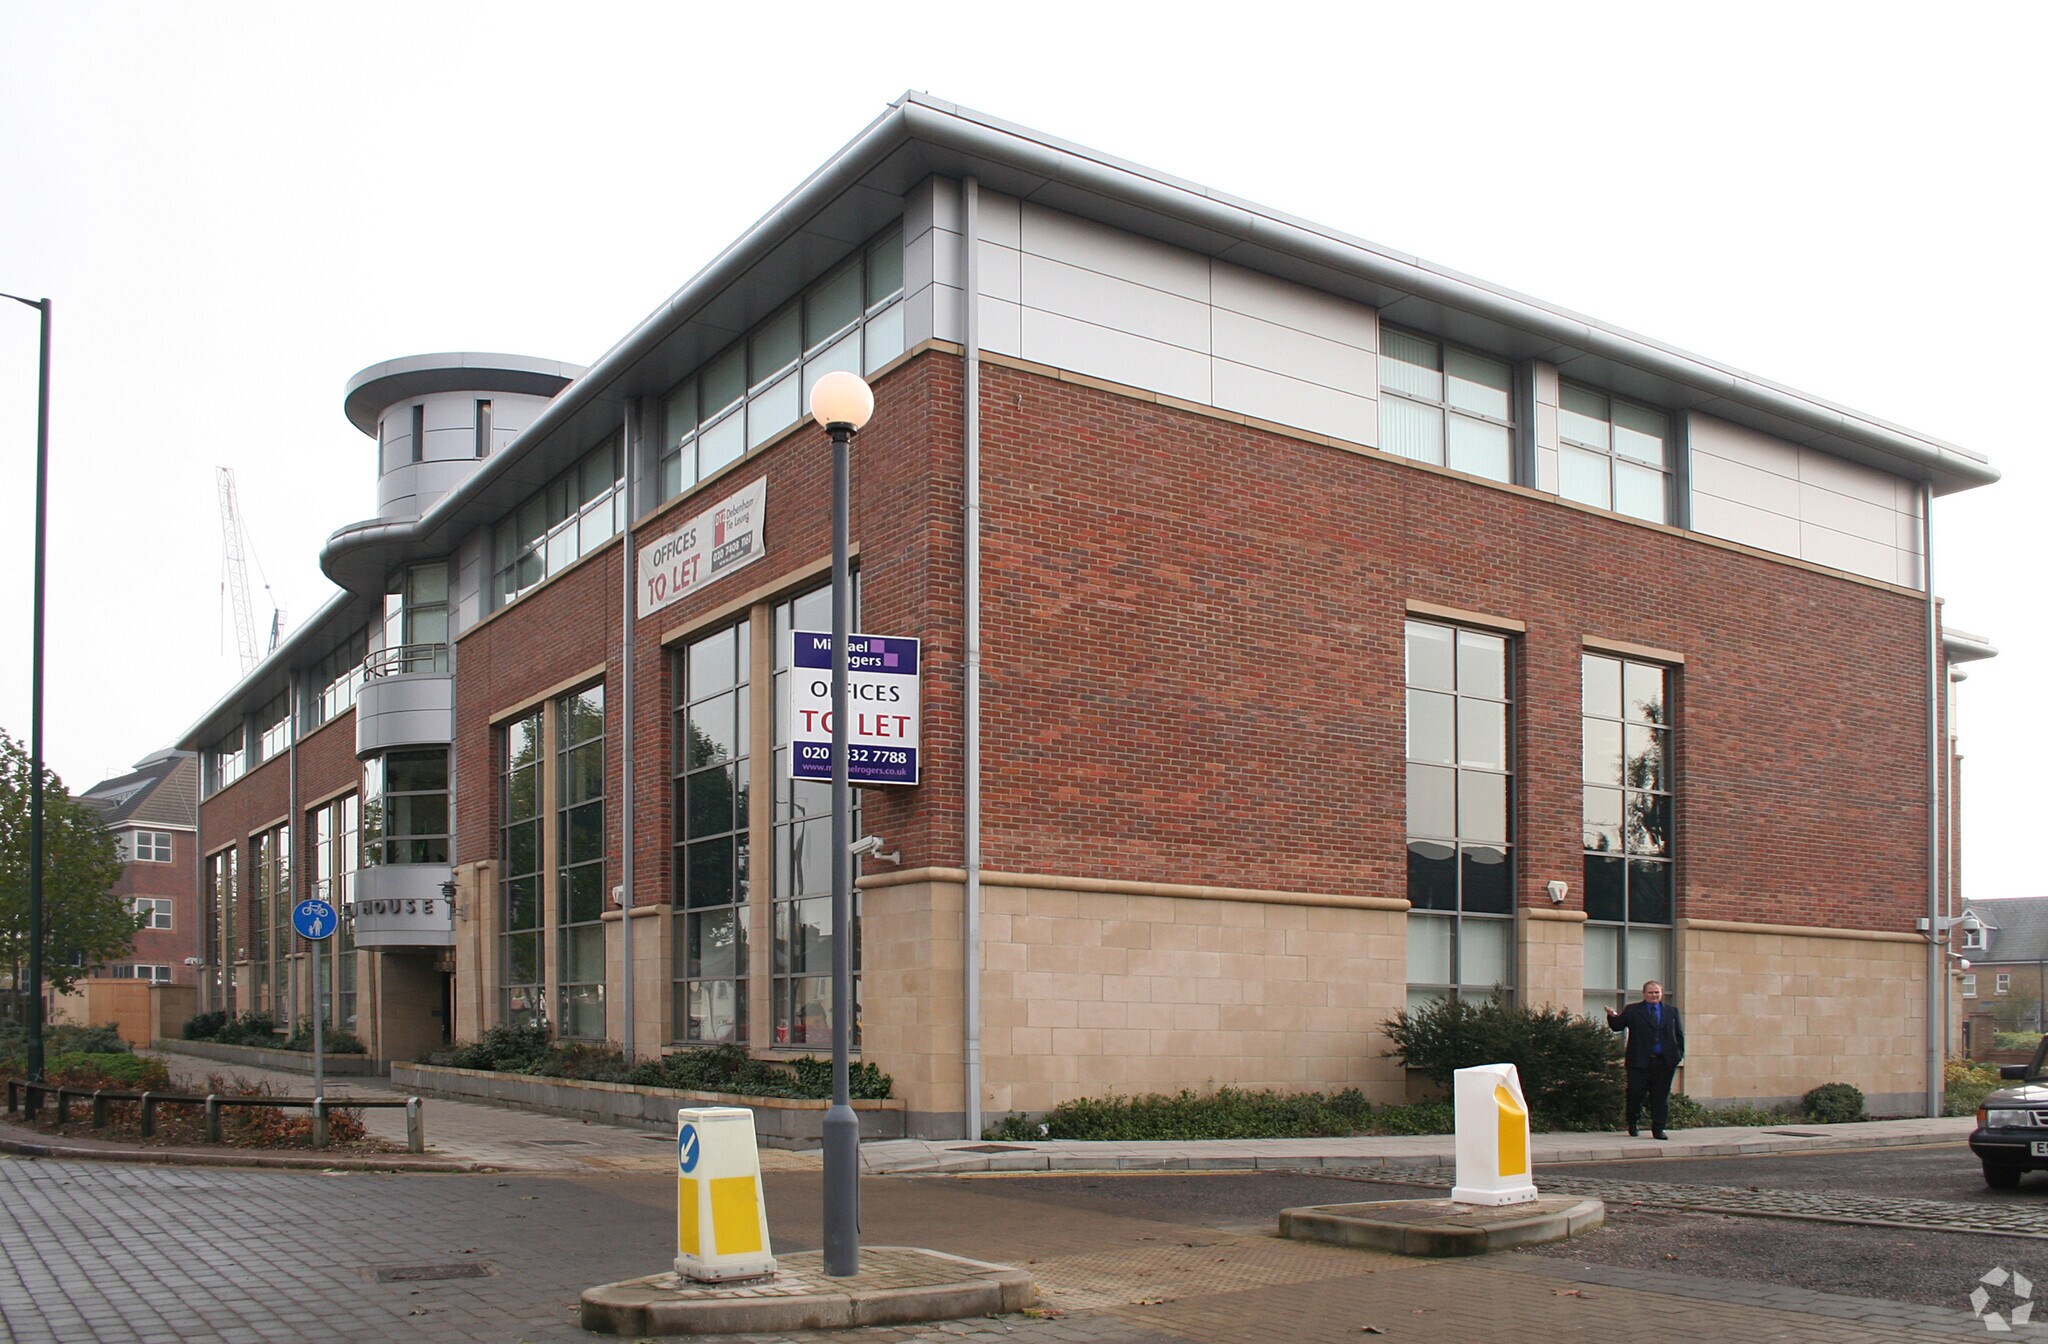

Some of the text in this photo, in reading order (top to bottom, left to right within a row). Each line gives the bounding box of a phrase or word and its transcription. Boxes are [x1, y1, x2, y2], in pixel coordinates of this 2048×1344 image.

[726, 498, 754, 520] Debenham
[726, 512, 750, 531] Tie Leung
[653, 528, 697, 567] OFFICES
[648, 553, 701, 606] TO LET
[813, 638, 868, 653] Miael
[811, 680, 900, 702] OICES
[859, 713, 911, 738] LET
[802, 746, 829, 760] 020
[873, 750, 907, 763] 7788
[362, 899, 434, 915] HOUSE
[2037, 1142, 2048, 1154] E
